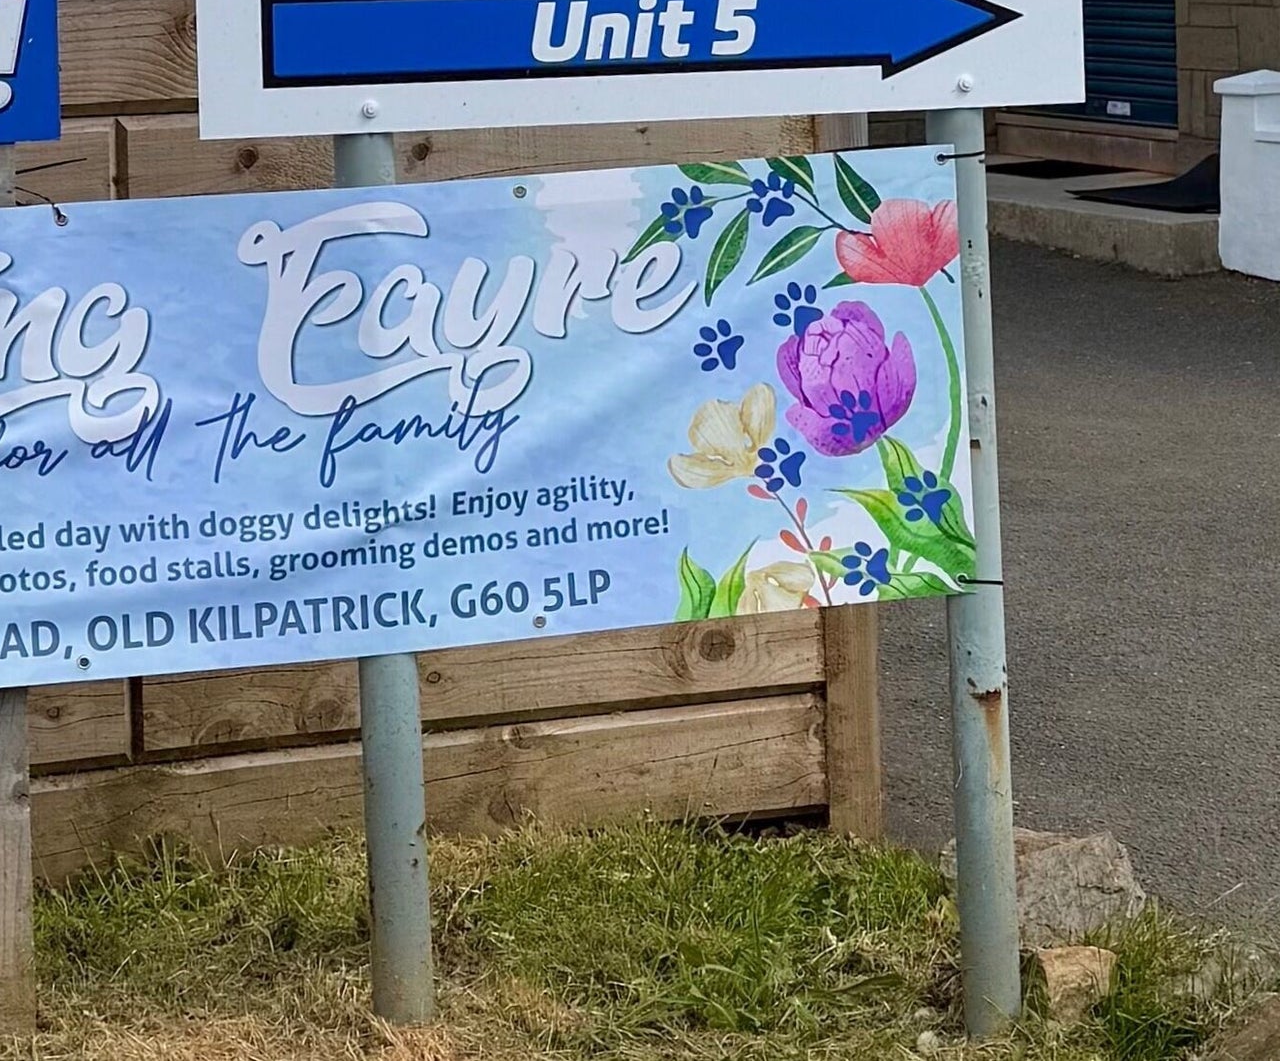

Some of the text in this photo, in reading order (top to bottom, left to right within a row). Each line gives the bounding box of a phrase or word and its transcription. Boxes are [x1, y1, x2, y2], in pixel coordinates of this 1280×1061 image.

[237, 201, 698, 417] Fayre
[91, 397, 172, 482] all
[196, 392, 305, 483] the
[319, 375, 519, 488] family
[55, 521, 110, 553] day
[119, 507, 189, 542] with
[199, 510, 293, 542] doggy
[303, 495, 437, 534] delights!
[452, 487, 528, 518] Enjoy
[536, 475, 634, 509] agility,
[86, 556, 157, 587] food
[168, 552, 259, 581] stalls,
[270, 540, 414, 581] grooming
[423, 525, 517, 559] demos
[526, 518, 577, 548] and
[587, 509, 669, 542] more!
[87, 610, 174, 651] OLD
[189, 589, 437, 644] KILPATRICK,
[451, 581, 528, 620] G60
[543, 569, 611, 613] 5LP
